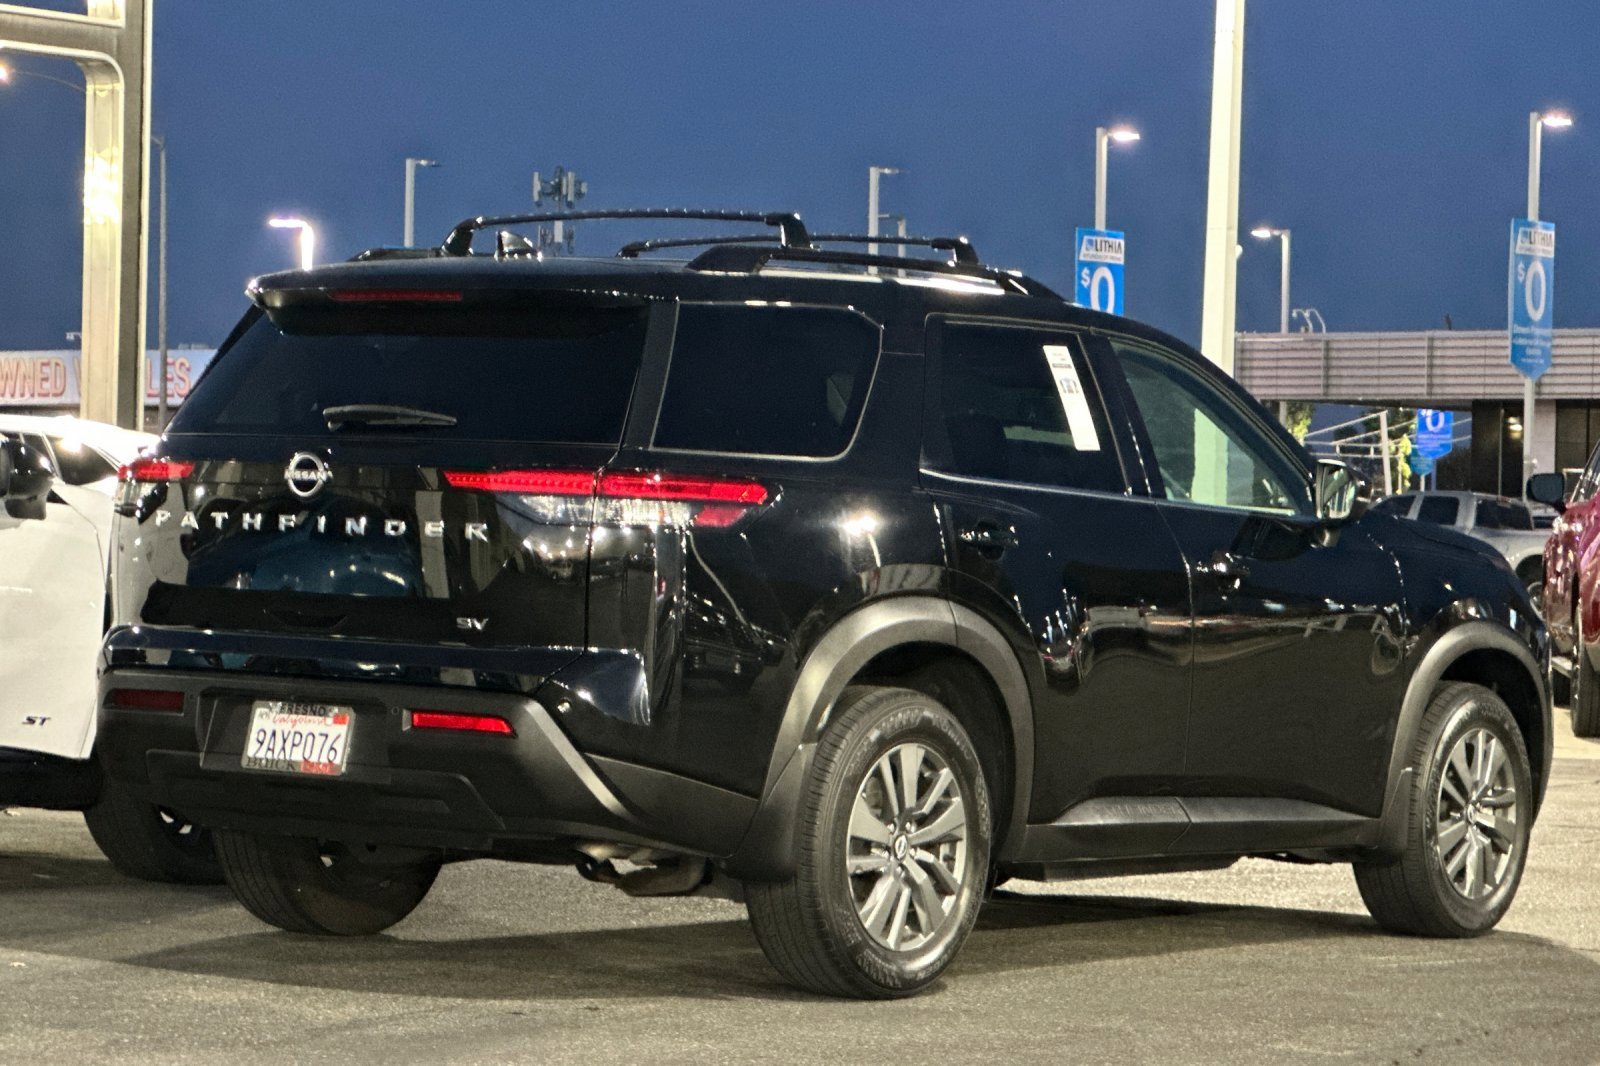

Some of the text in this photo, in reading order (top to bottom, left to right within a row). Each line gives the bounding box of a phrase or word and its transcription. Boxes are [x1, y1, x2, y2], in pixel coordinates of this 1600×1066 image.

[1095, 238, 1123, 254] LITHIA
[284, 468, 328, 482] NISSAN
[154, 510, 489, 542] PATHFINDER
[456, 617, 489, 631] SV
[280, 703, 327, 717] FRESNO
[22, 715, 52, 726] ST
[253, 728, 342, 763] 9AXP076
